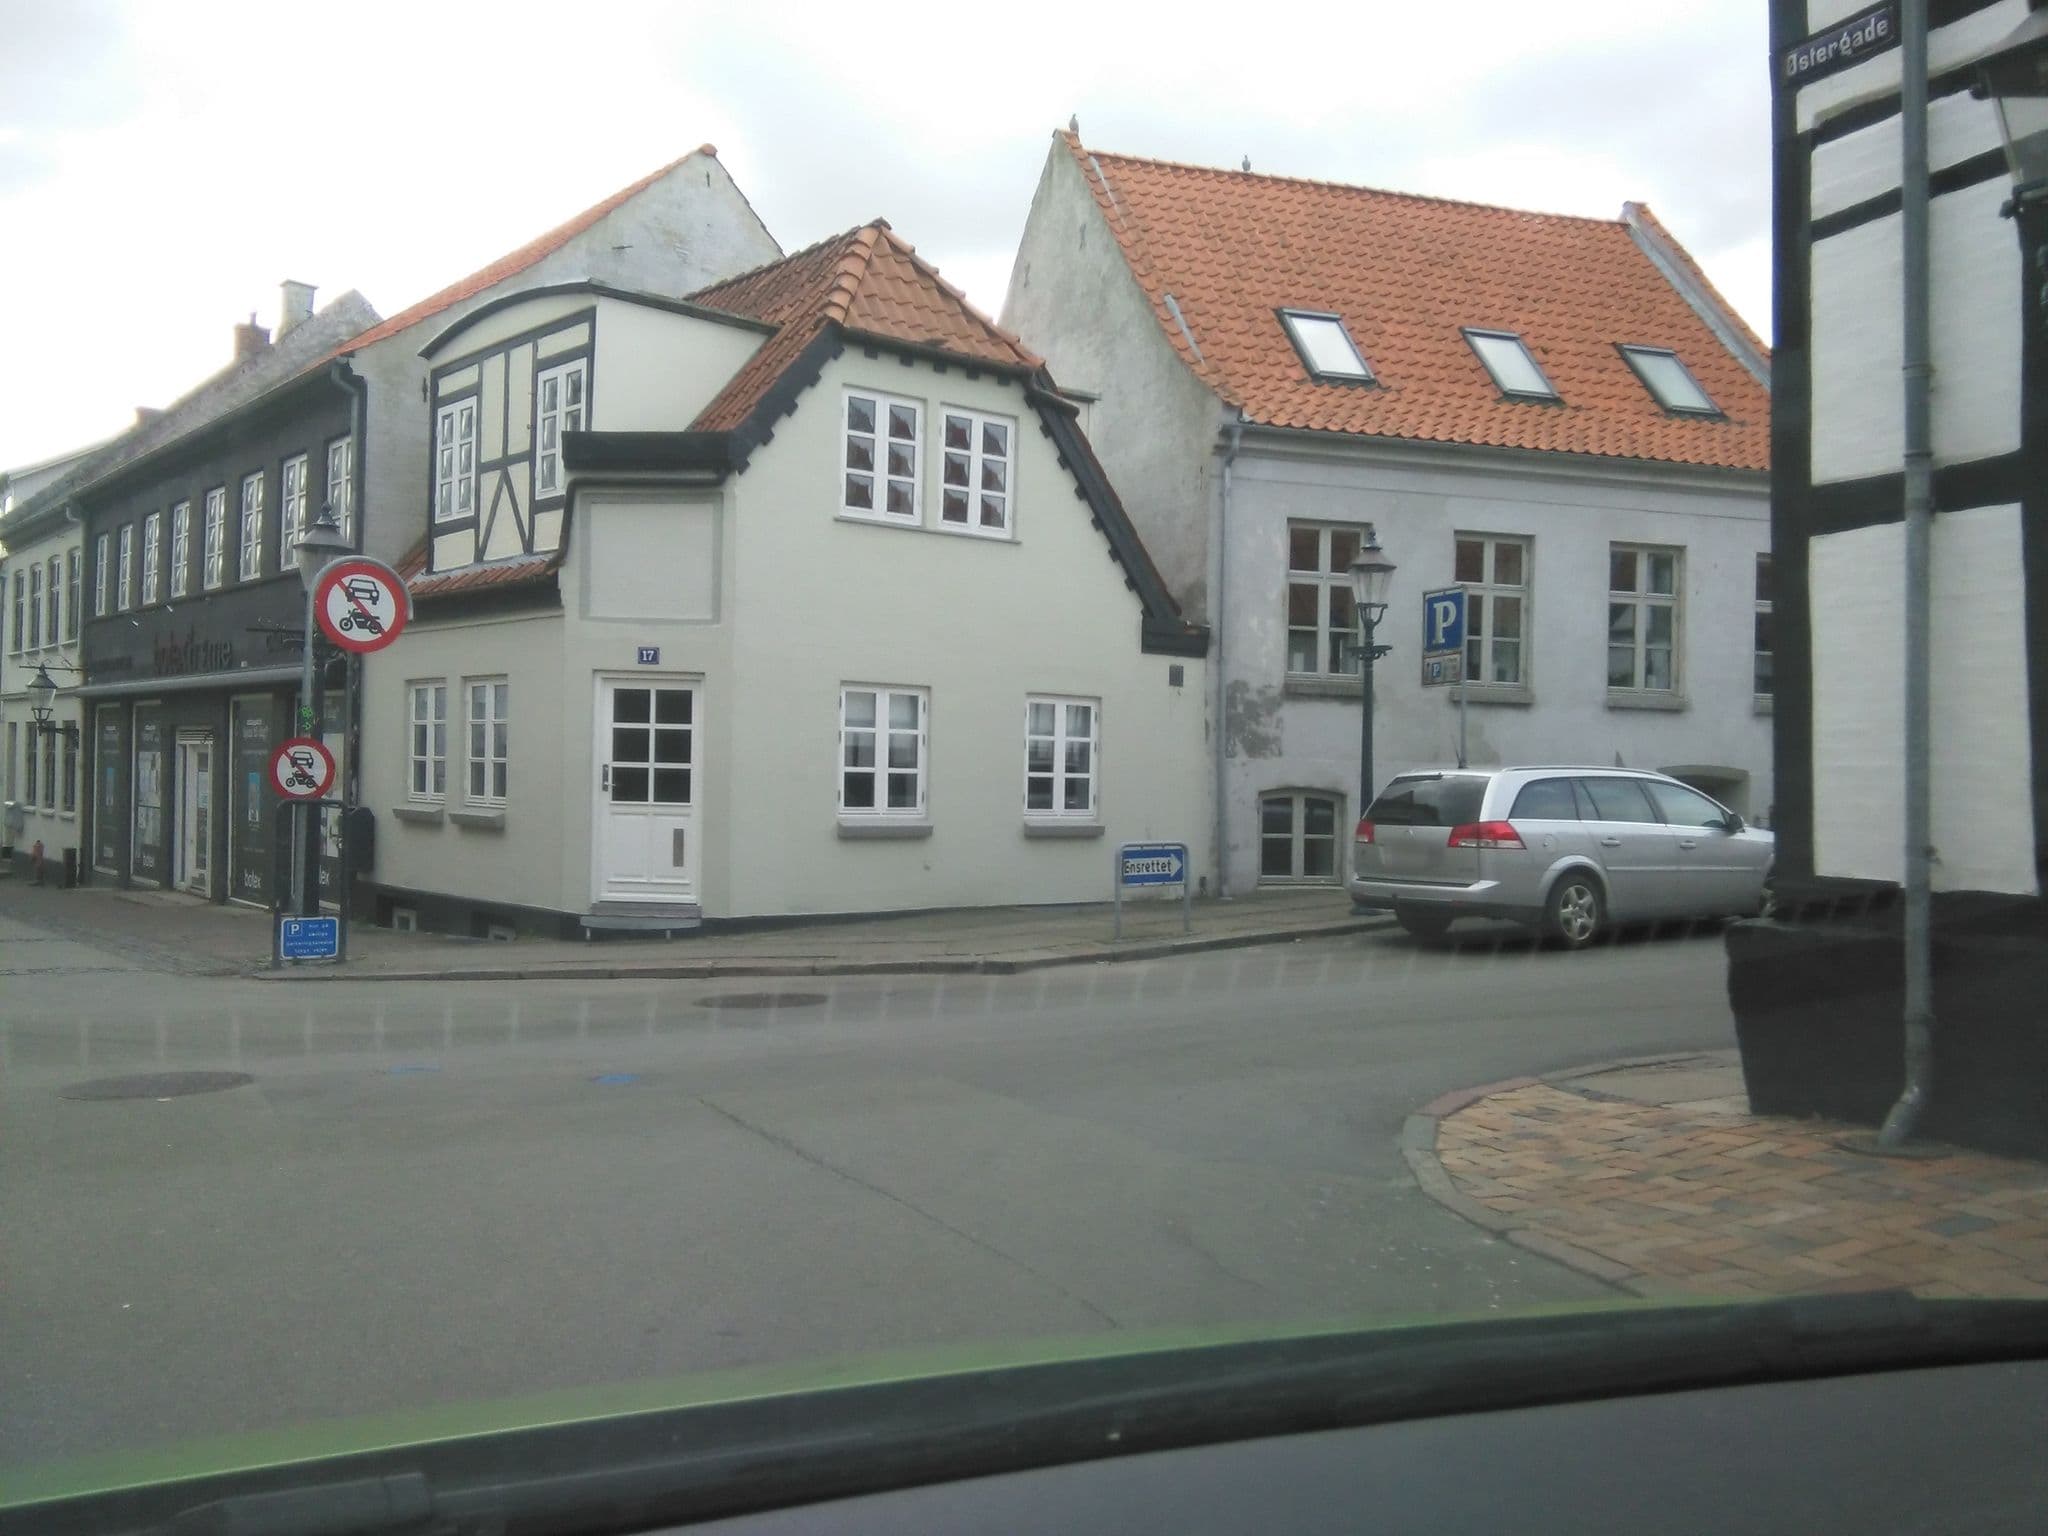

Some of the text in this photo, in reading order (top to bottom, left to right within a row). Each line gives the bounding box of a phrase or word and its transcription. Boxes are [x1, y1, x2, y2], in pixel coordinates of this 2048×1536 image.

[1433, 600, 1457, 644] P
[642, 650, 654, 661] 17
[1124, 860, 1171, 873] Ensrettet
[291, 924, 300, 935] P
